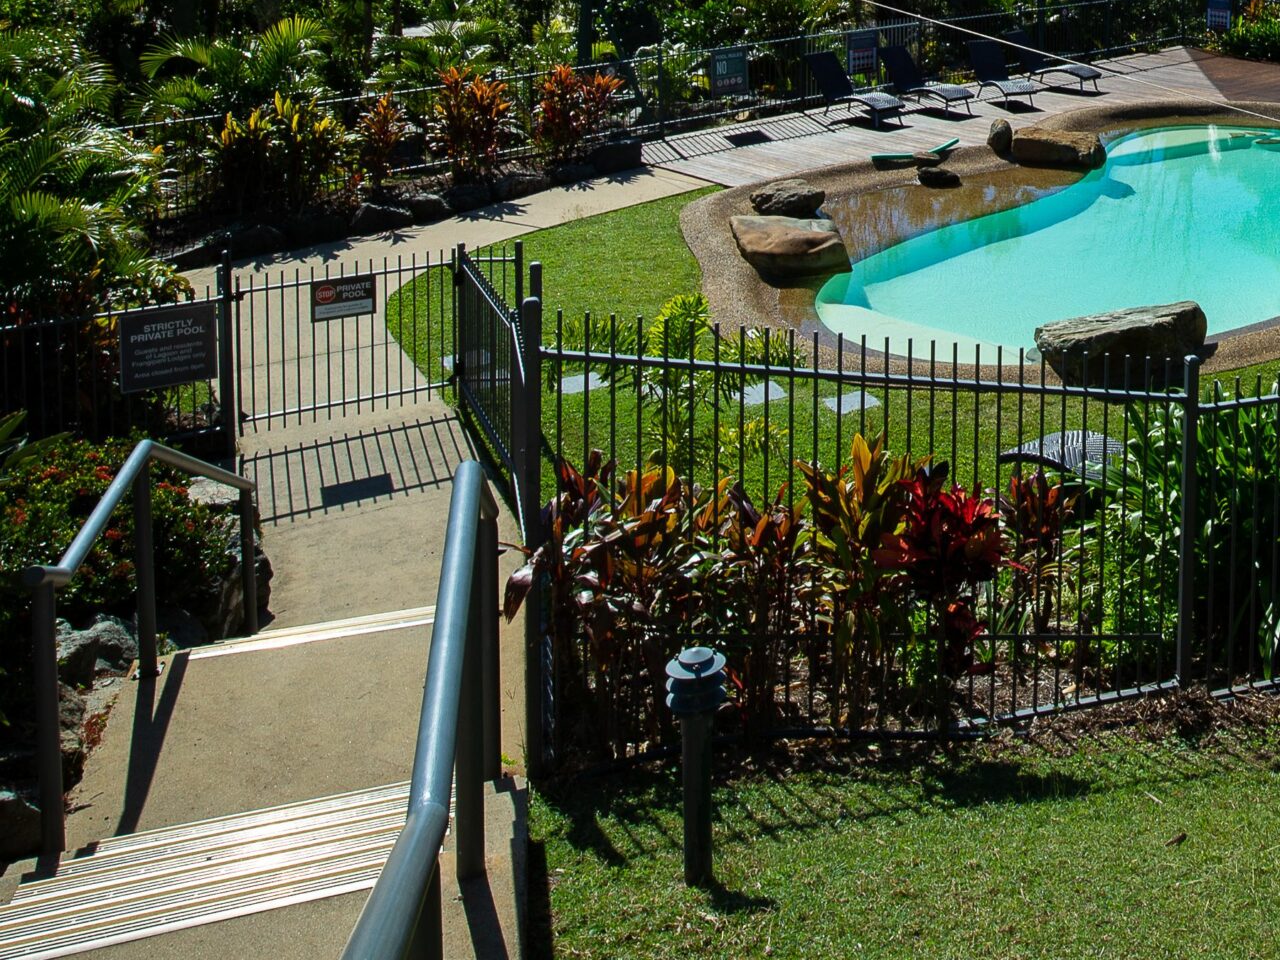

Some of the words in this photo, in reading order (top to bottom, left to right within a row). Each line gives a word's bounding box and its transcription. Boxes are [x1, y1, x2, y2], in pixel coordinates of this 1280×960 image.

[716, 60, 727, 75] NO
[336, 281, 372, 292] PRIVATE
[318, 290, 333, 298] STOP
[342, 290, 366, 299] POOL
[143, 319, 193, 333] STRICTLY
[130, 330, 174, 343] PRIVATE
[177, 325, 205, 336] POOL
[134, 347, 158, 355] Guests
